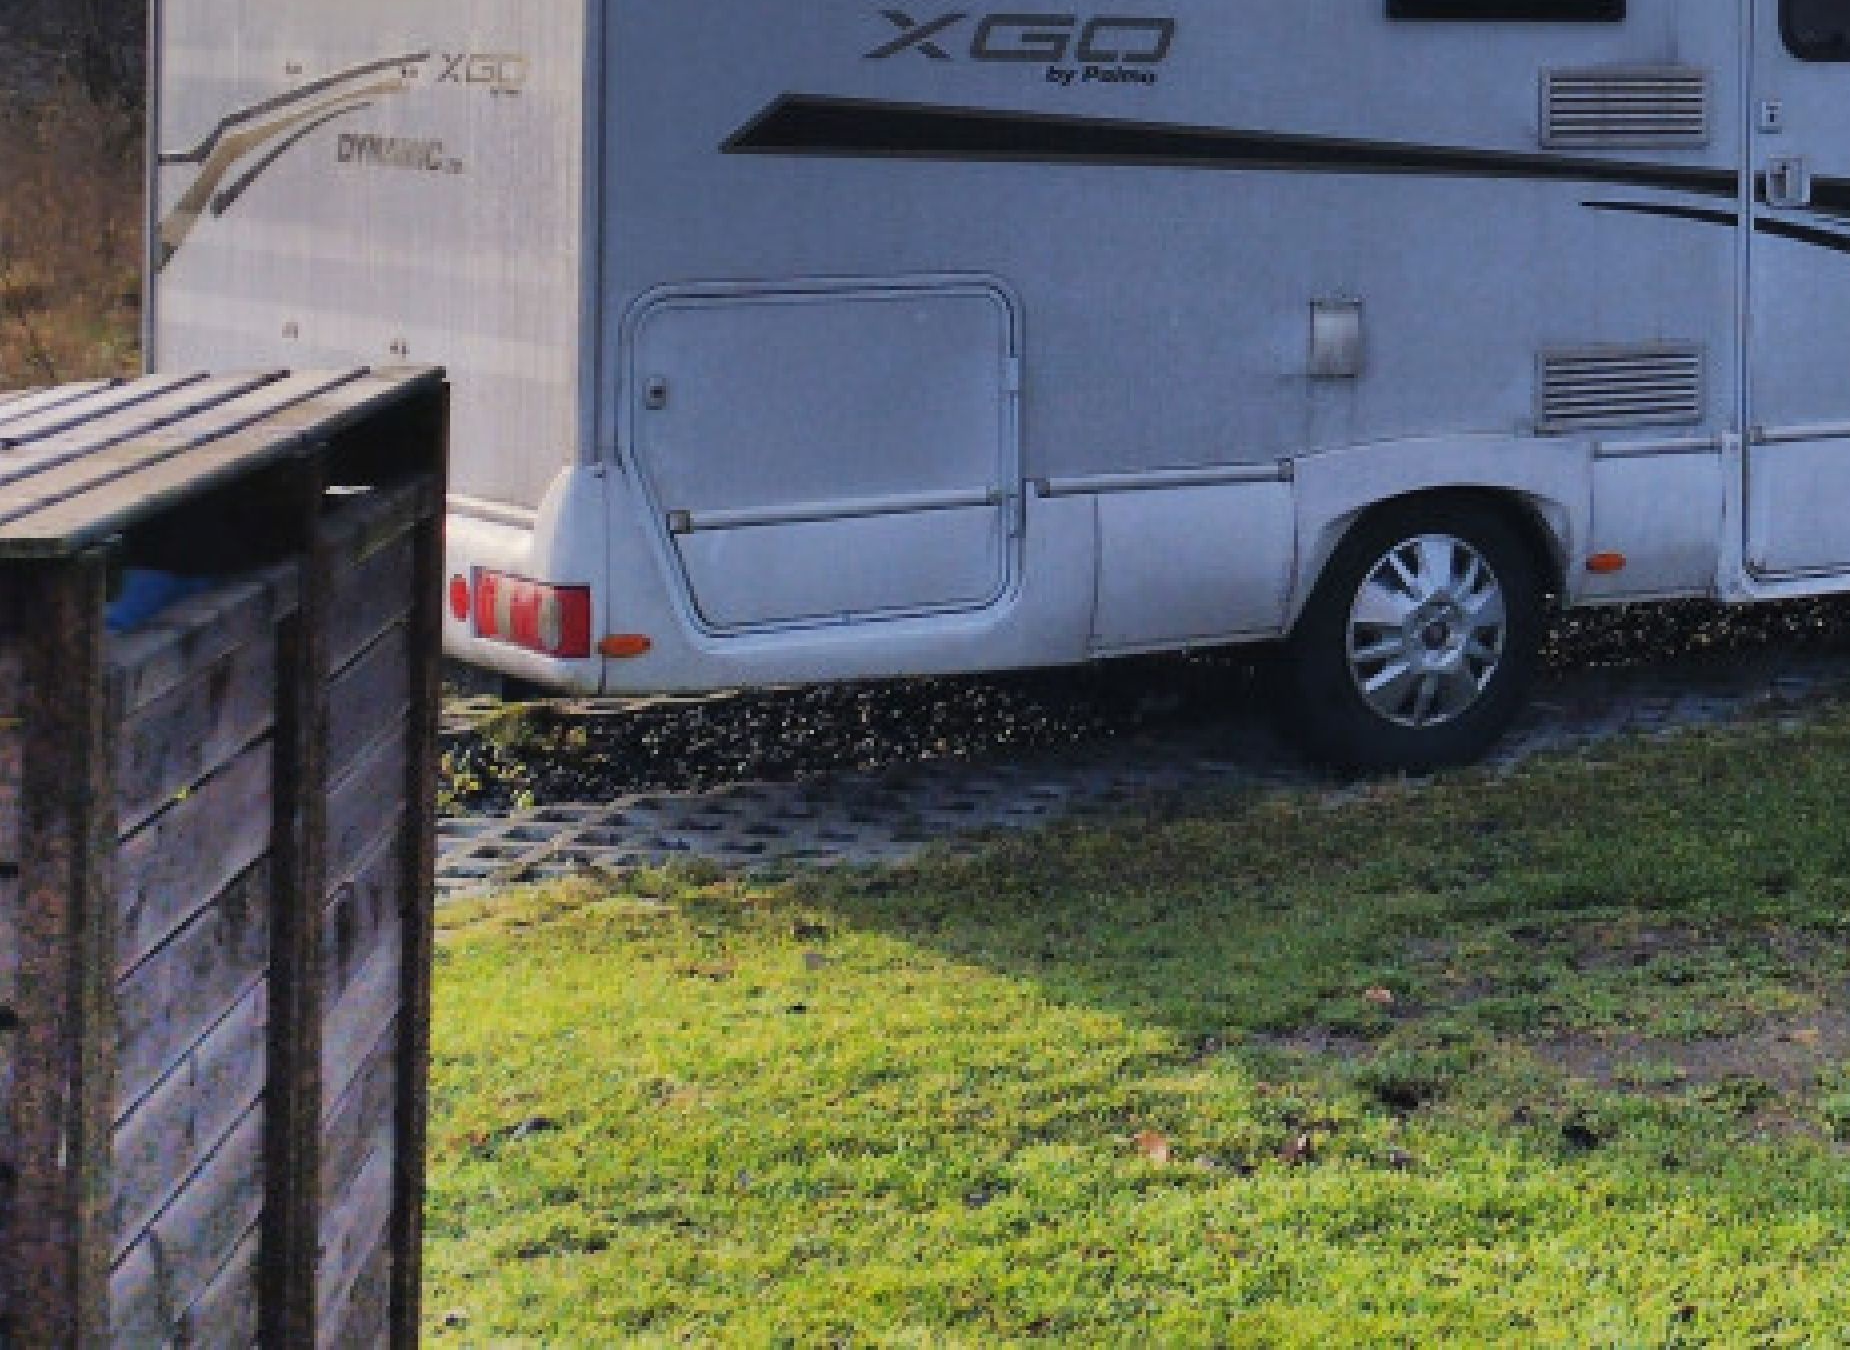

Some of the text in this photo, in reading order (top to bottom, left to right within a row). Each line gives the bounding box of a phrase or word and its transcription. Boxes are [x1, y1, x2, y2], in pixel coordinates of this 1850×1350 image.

[862, 8, 1175, 62] XGO
[438, 53, 529, 84] XGO
[1045, 66, 1076, 86] by
